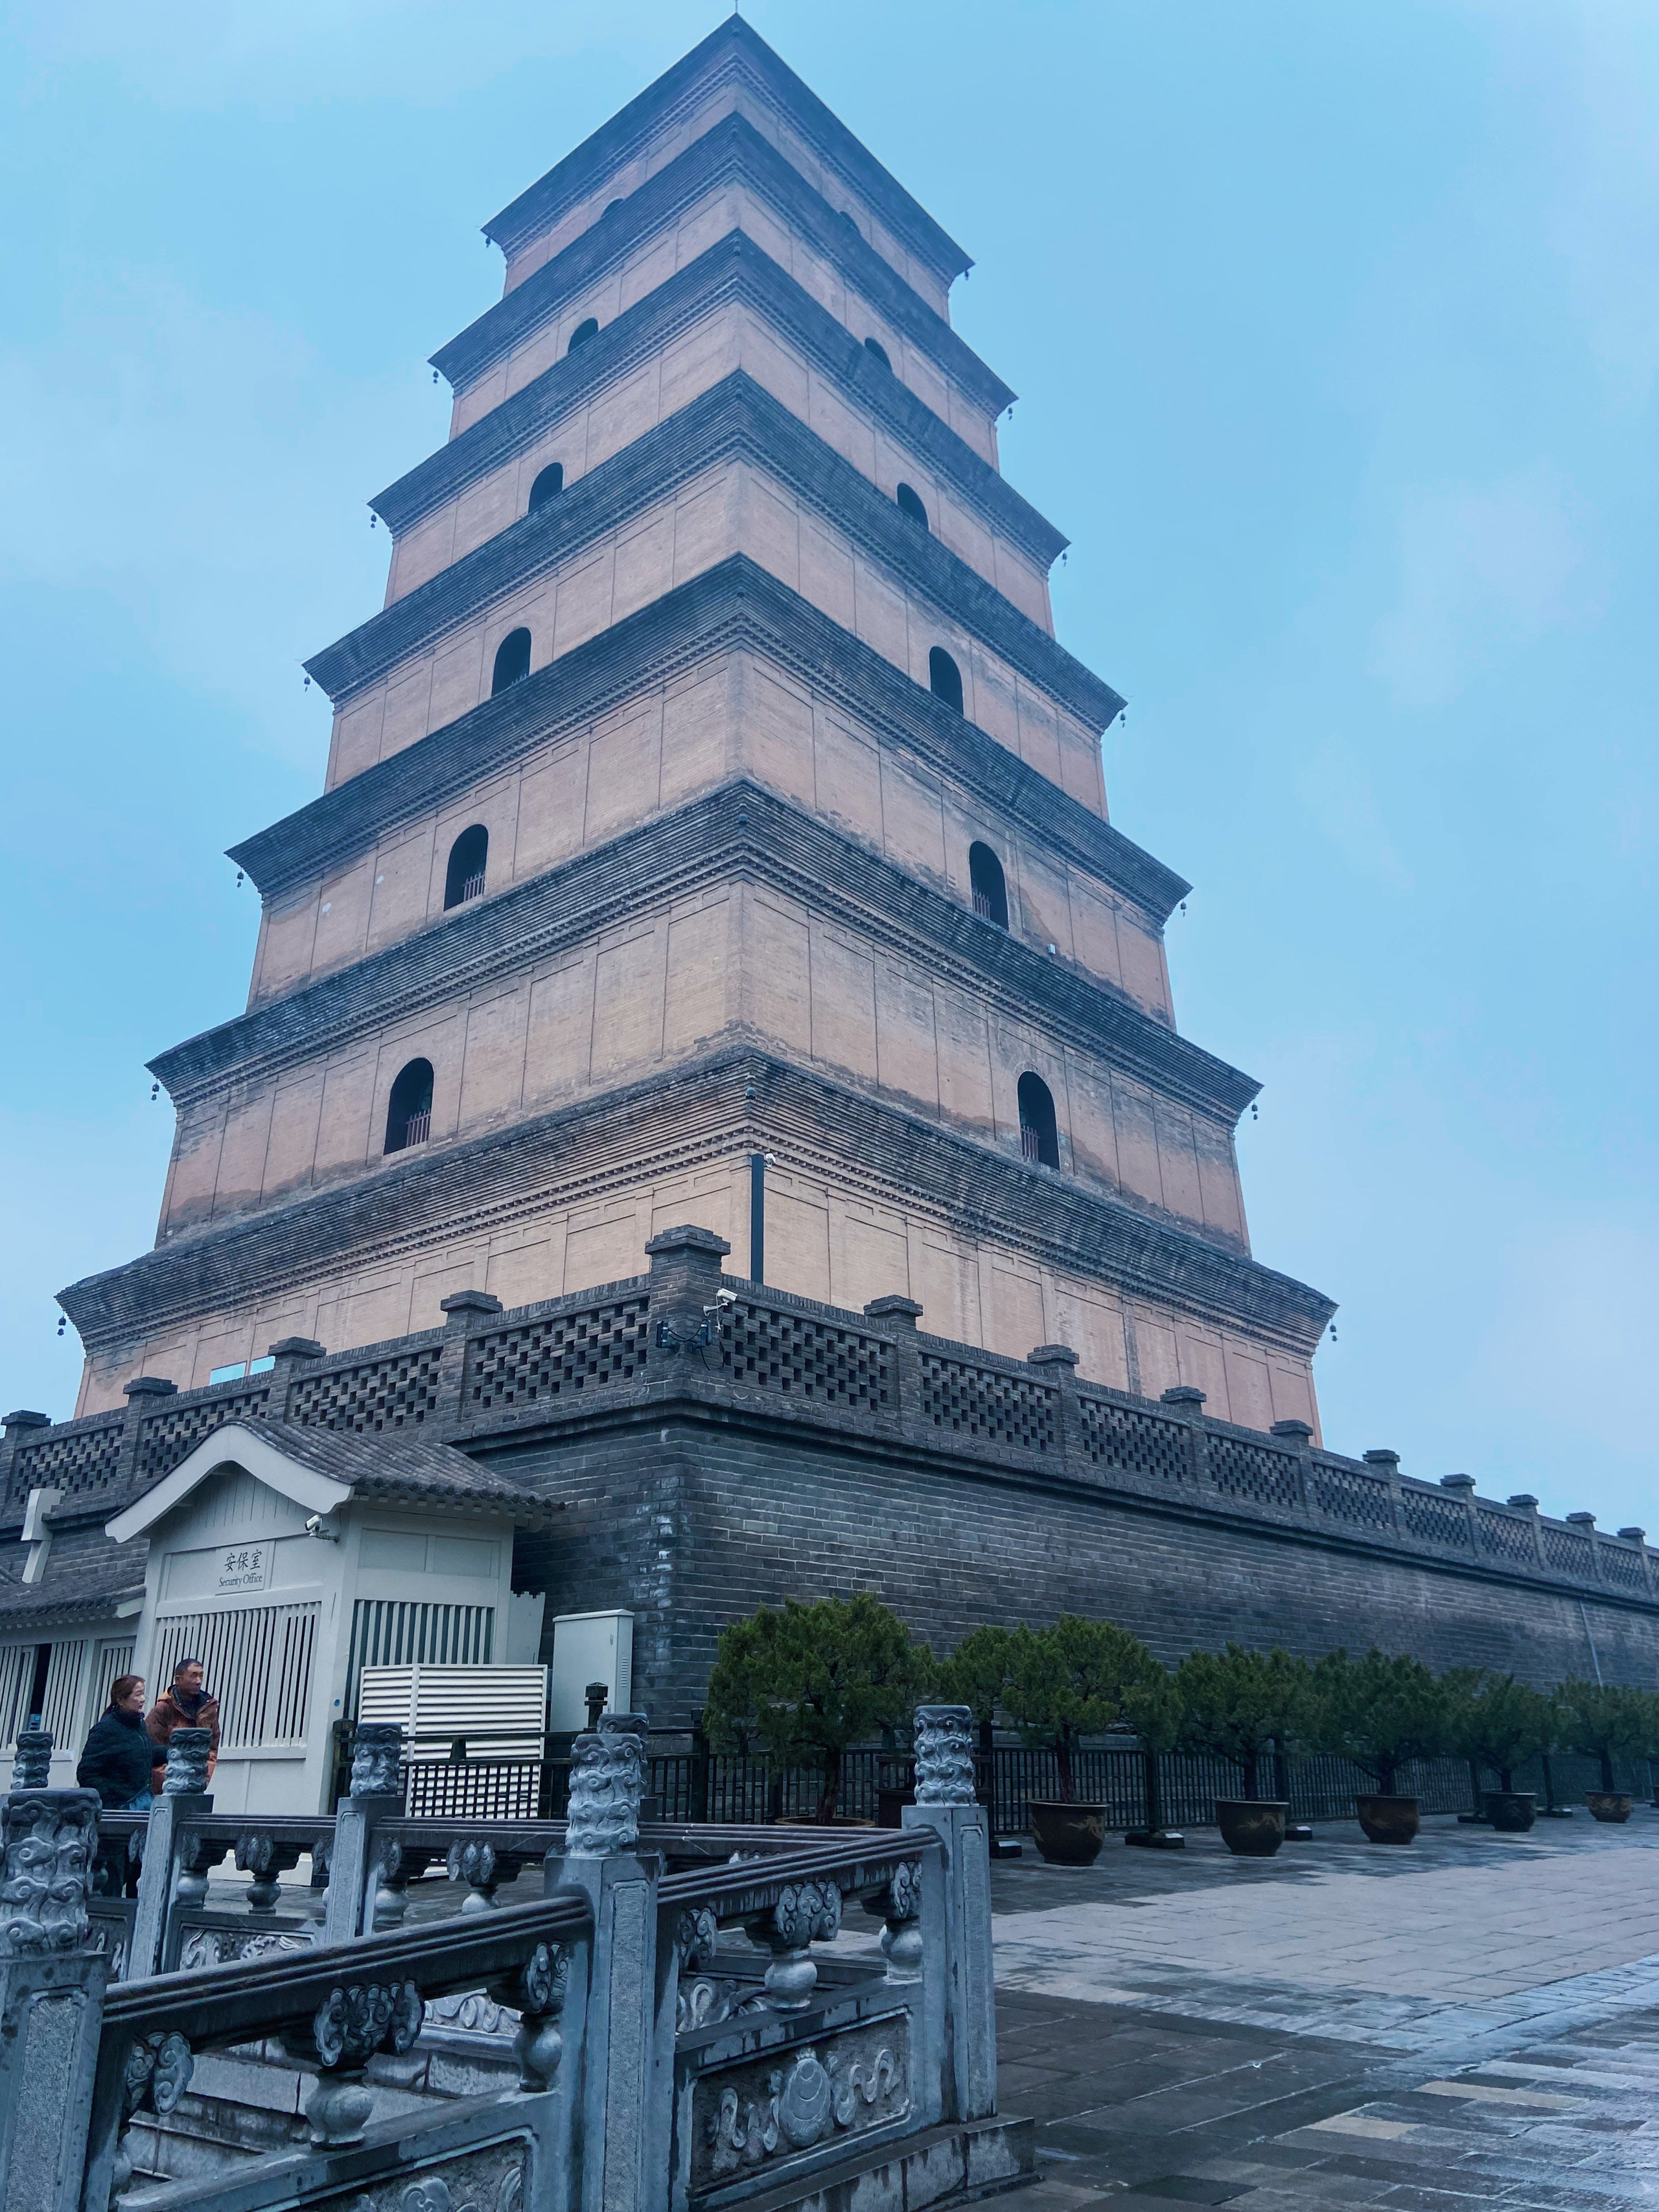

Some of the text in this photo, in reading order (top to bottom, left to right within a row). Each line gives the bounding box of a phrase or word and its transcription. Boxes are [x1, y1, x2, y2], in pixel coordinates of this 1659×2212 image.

[224, 1549, 262, 1572] 安保室
[218, 1573, 262, 1587] Security Office
